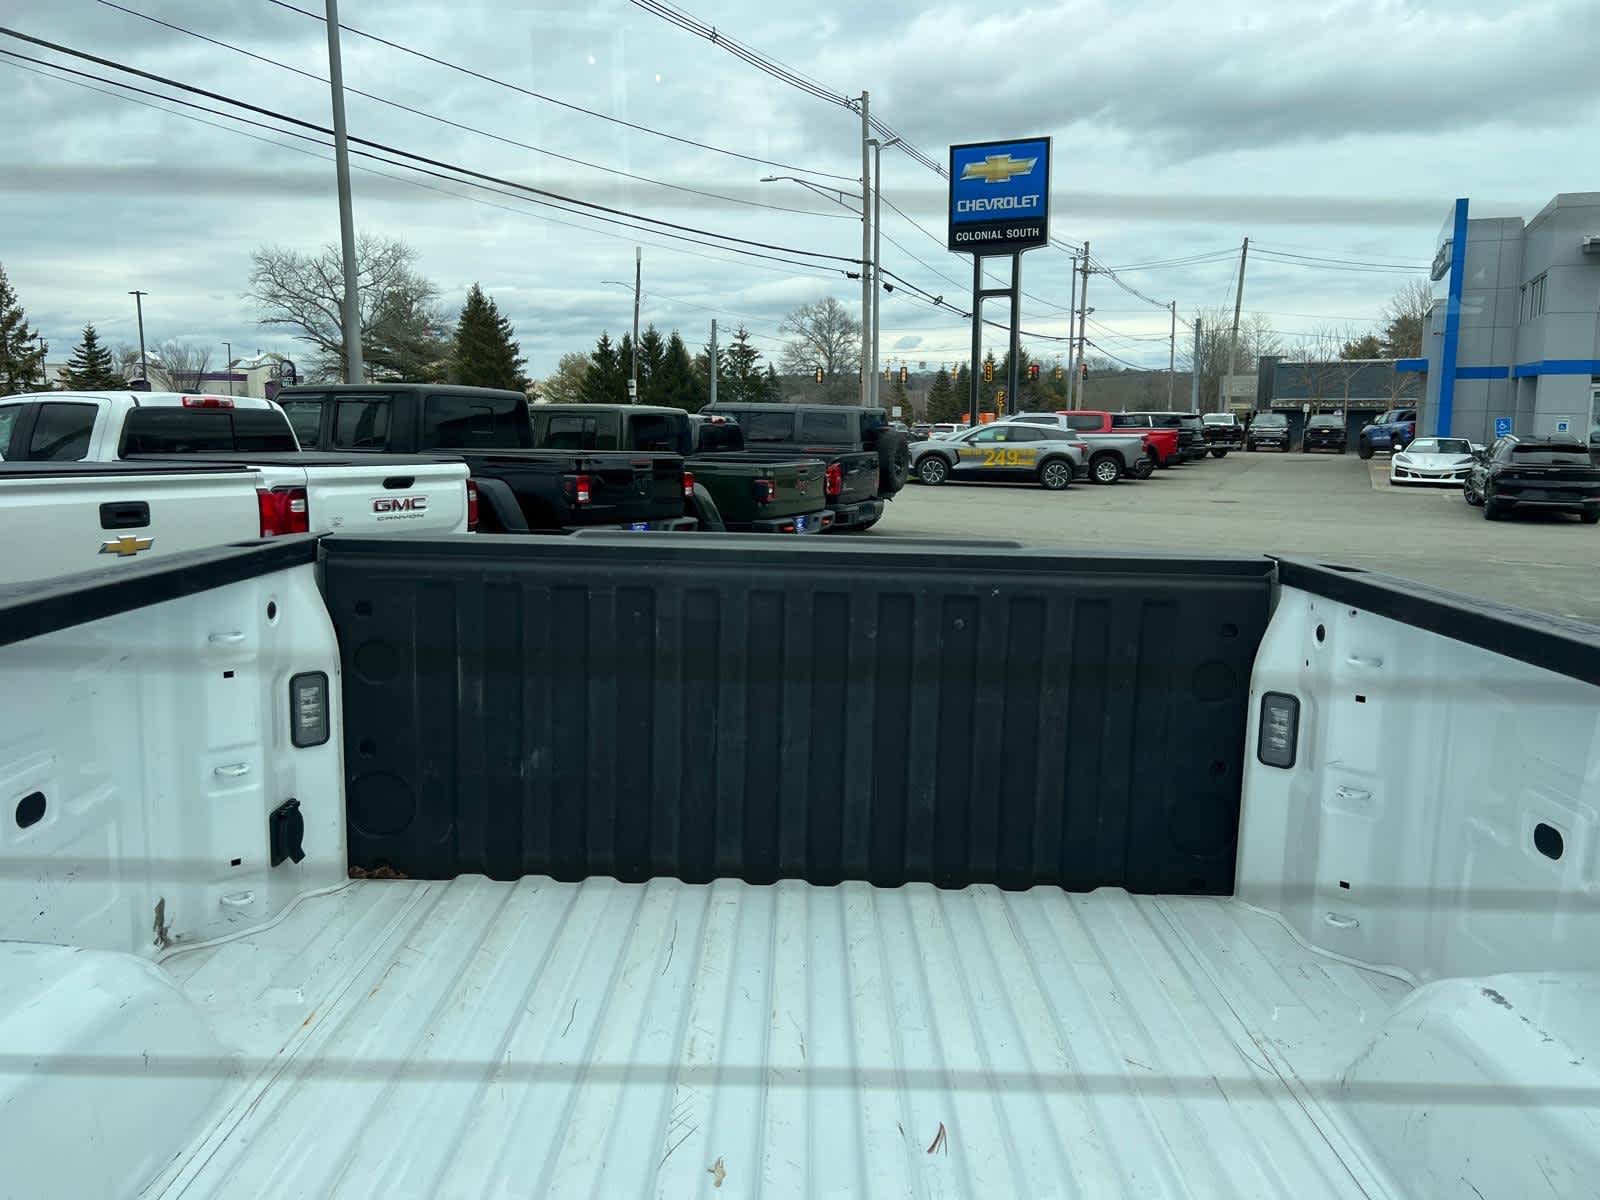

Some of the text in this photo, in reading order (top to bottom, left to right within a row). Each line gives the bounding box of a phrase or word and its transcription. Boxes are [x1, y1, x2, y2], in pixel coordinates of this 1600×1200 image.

[957, 195, 1039, 212] CHEVROLET
[956, 228, 1039, 241] COLONIAL SOUTH
[983, 448, 1018, 465] 249
[373, 497, 427, 512] GMC
[377, 513, 424, 521] CANYON
